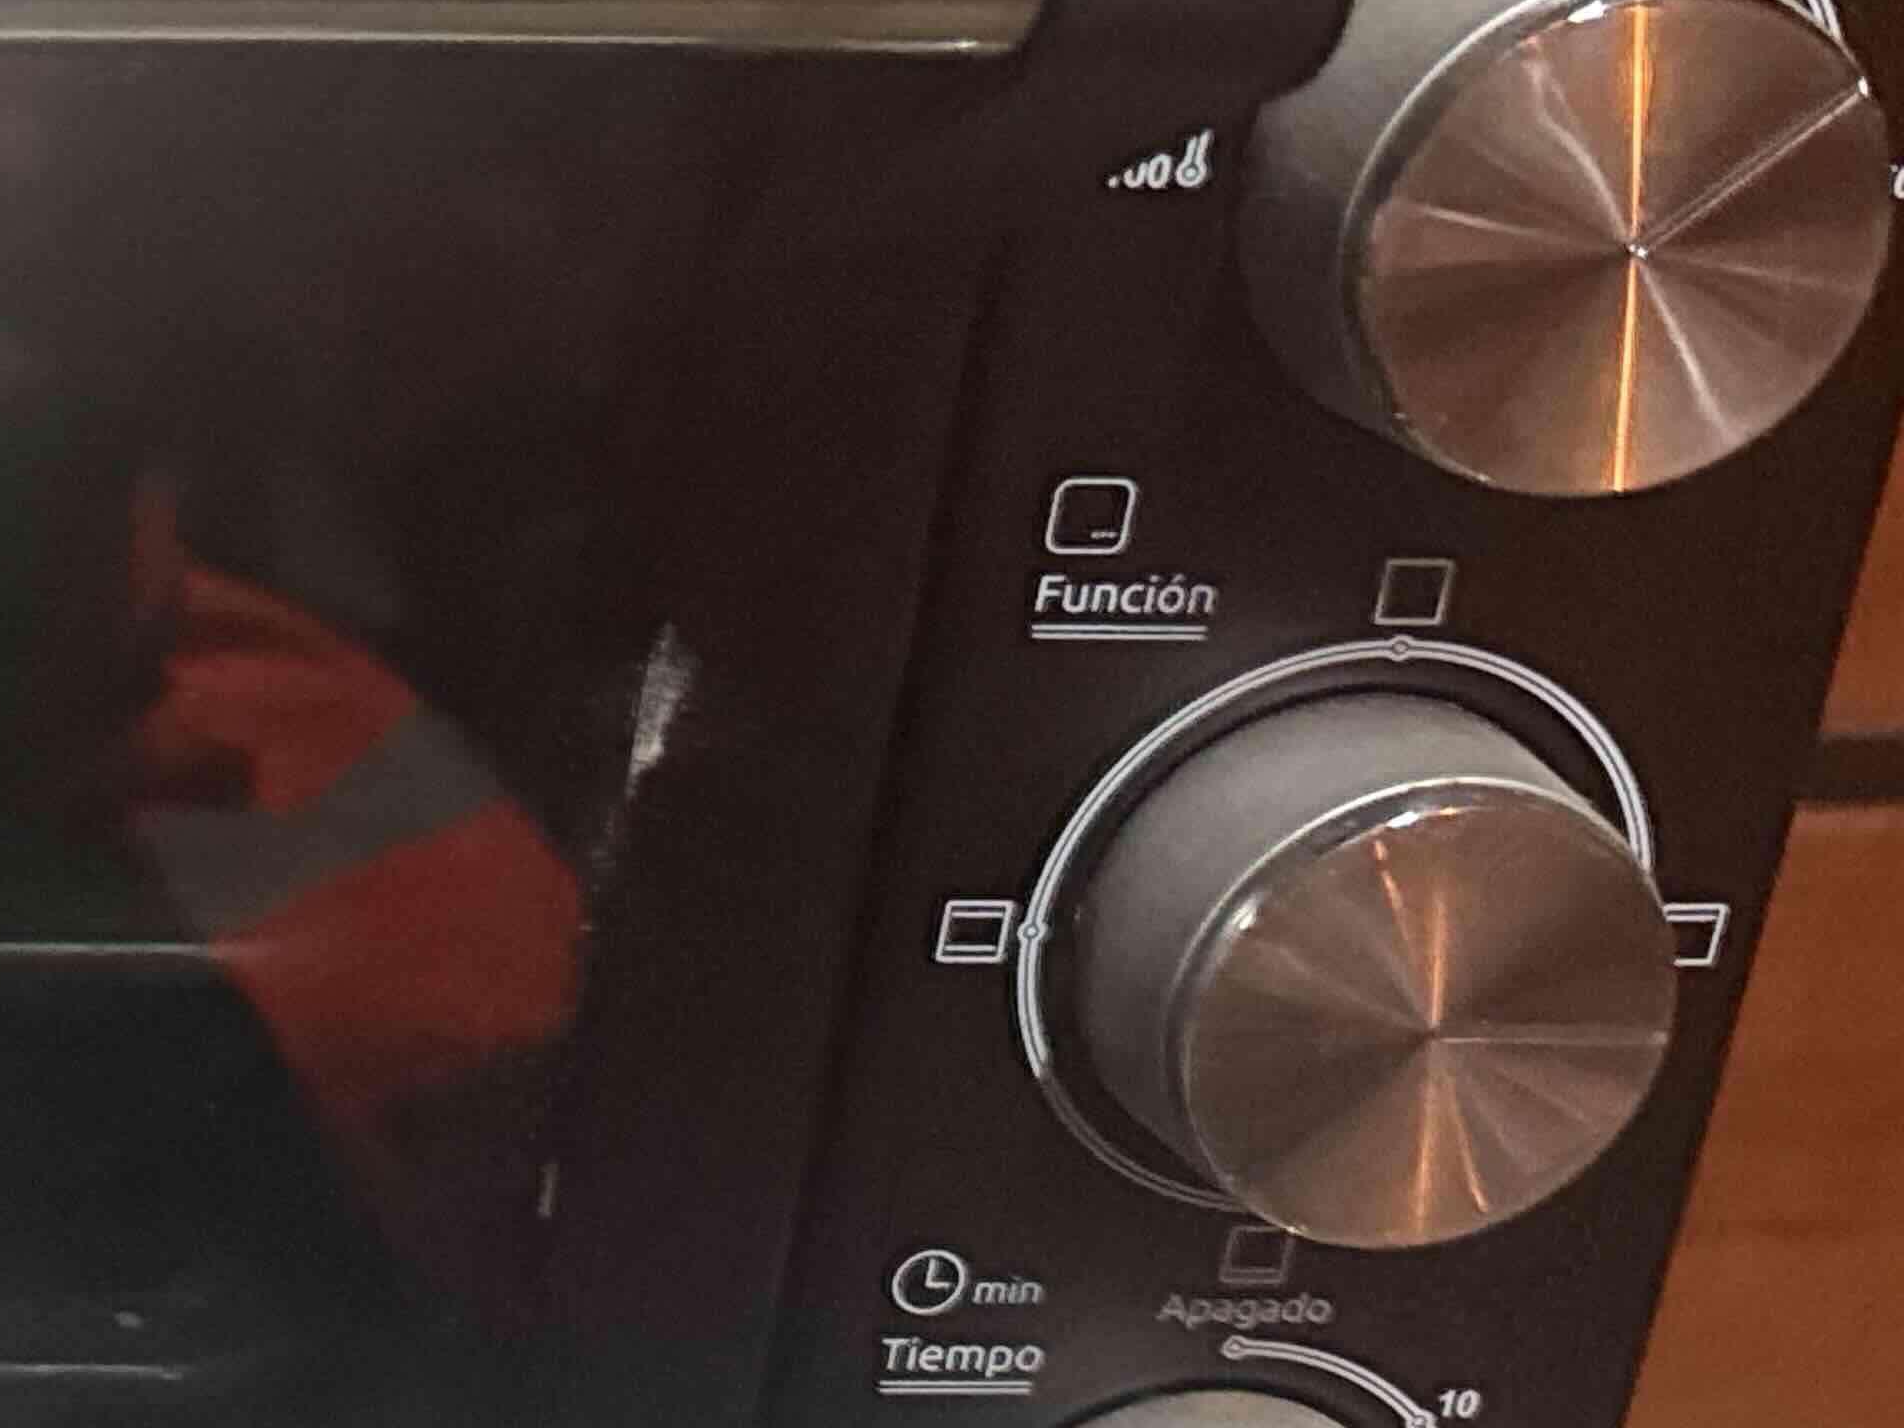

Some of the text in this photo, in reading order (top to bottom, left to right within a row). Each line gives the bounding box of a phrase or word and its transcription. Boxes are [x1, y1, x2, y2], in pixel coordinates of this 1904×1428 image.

[1033, 572, 1216, 616] Función
[972, 1275, 1044, 1305] min
[1155, 1292, 1334, 1327] Apagado
[881, 1336, 1045, 1373] Tiempo
[1438, 1388, 1482, 1419] 10
